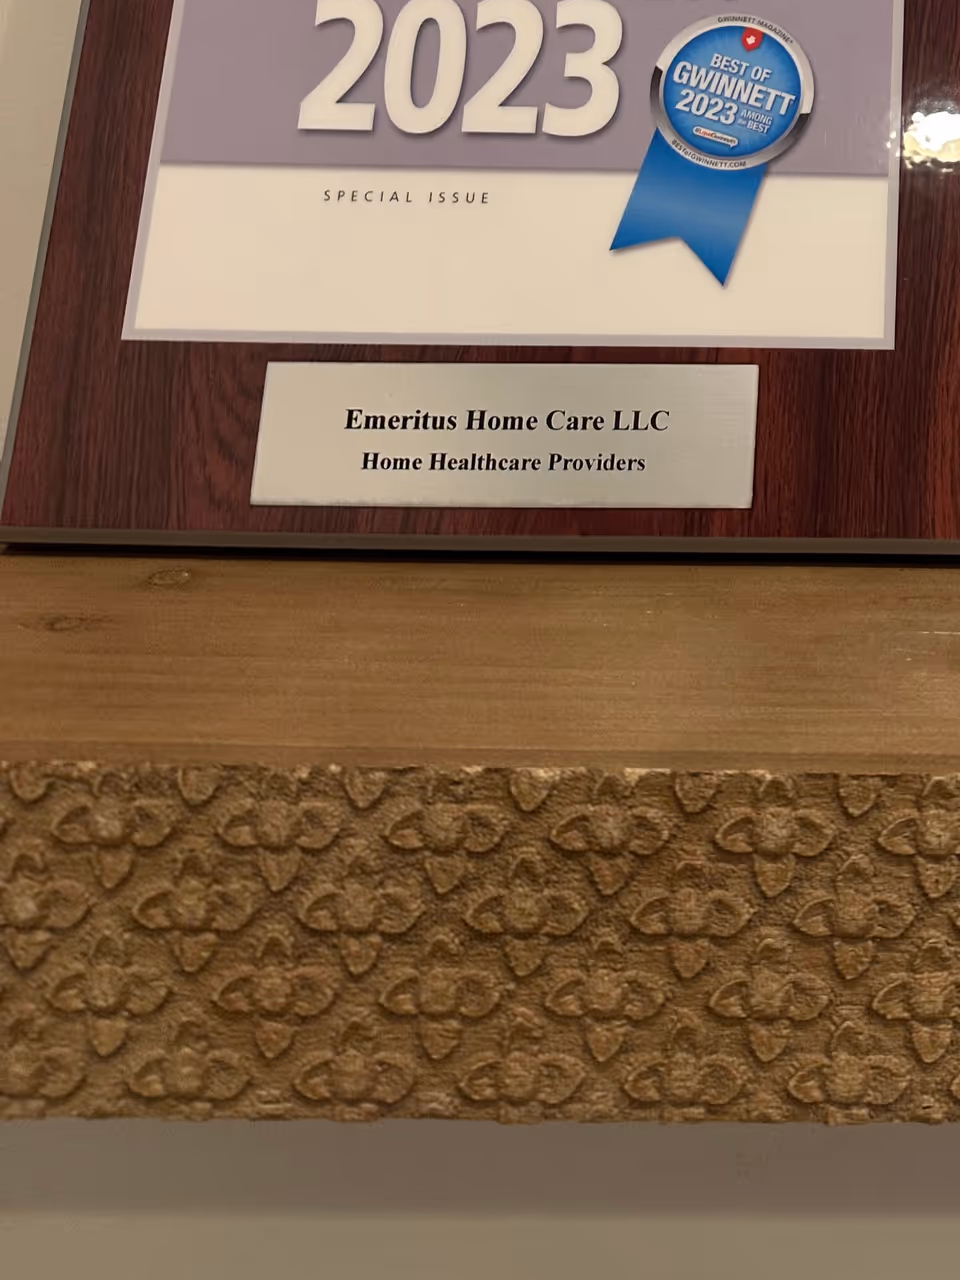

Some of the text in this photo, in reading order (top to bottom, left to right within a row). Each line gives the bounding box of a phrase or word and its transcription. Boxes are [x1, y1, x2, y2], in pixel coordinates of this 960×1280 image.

[717, 15, 757, 24] GWINNETT
[710, 53, 773, 83] BEST OF
[672, 60, 796, 116] GWINNETT
[674, 88, 738, 126] 2023
[740, 109, 773, 125] AMONG
[746, 122, 771, 134] BEST
[323, 189, 489, 205] SPECIAL ISSUE
[344, 408, 670, 431] Emeritus Home Care LLC
[361, 452, 646, 472] Home Healthcare Providers
